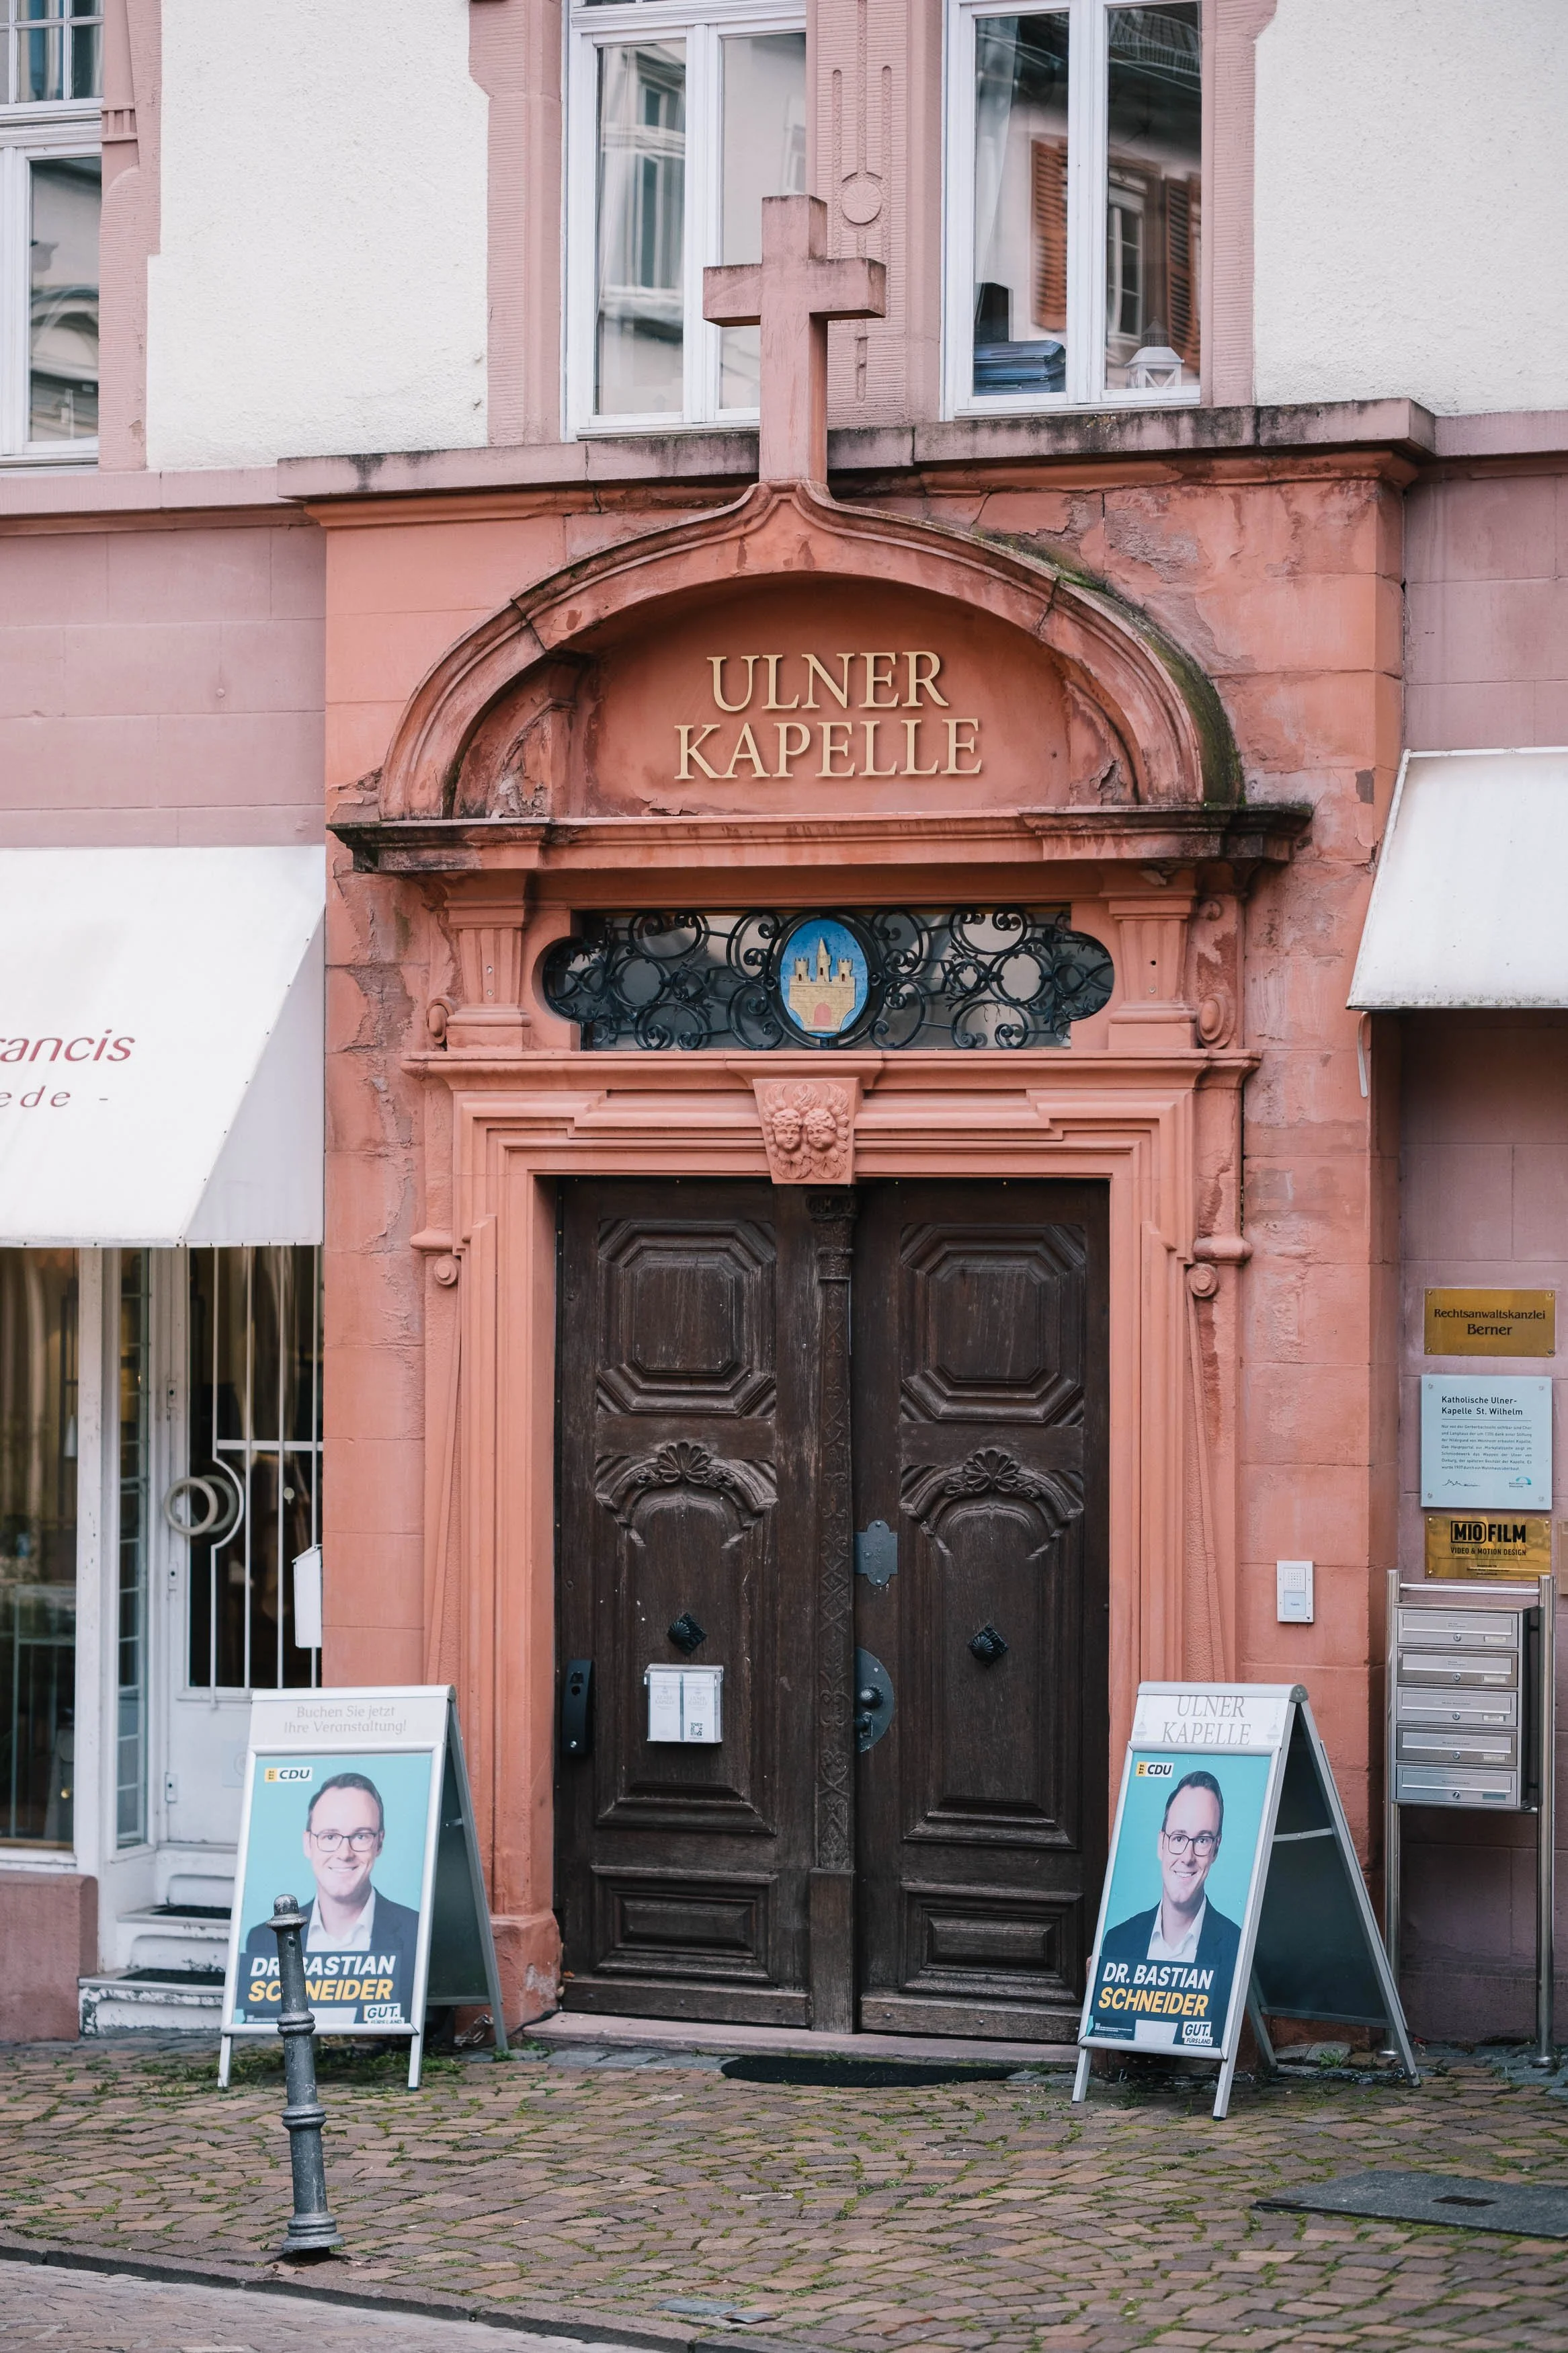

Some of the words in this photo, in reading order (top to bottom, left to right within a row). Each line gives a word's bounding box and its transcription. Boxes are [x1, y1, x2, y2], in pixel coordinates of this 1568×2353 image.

[706, 651, 949, 712] ULNER
[674, 718, 982, 780] KAPELLE
[0, 1029, 135, 1062] ancis
[1434, 1308, 1545, 1320] Rechtsanwaltskanzlei
[1467, 1324, 1512, 1335] Berner
[1442, 1396, 1489, 1404] Katholische
[1442, 1407, 1472, 1416] Kapelle
[1476, 1407, 1487, 1415] St.
[296, 1706, 343, 1718] Buchen
[346, 1705, 365, 1717] Sie
[368, 1705, 395, 1720] jetzt
[1178, 1696, 1245, 1718] ULNER
[284, 1722, 309, 1733] Ihre
[313, 1719, 407, 1735] Veranstaltung!
[1162, 1721, 1251, 1745] KAPELLE
[280, 1769, 310, 1780] CDU
[1147, 1764, 1172, 1776] CDU
[1102, 1962, 1130, 1984] DR.
[1133, 1964, 1214, 1989] BASTIAN
[248, 1979, 394, 2002] SCNEIDER
[1098, 1987, 1209, 2017] SCHNEIDER
[368, 2005, 398, 2018] GUT.
[1185, 2024, 1210, 2036] GUT.
